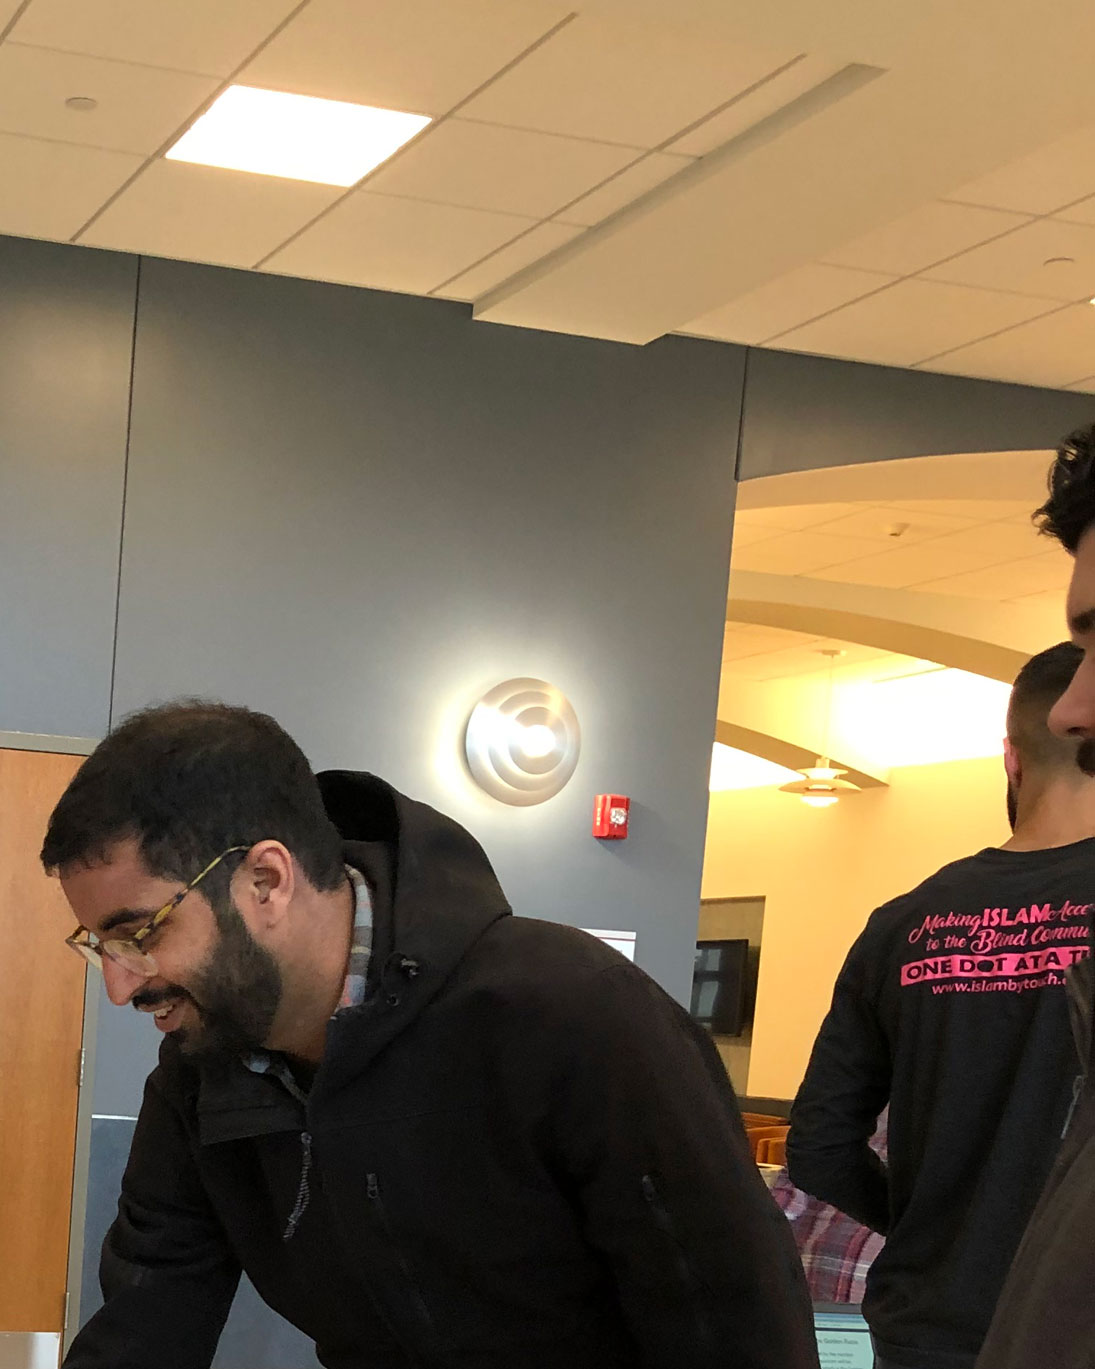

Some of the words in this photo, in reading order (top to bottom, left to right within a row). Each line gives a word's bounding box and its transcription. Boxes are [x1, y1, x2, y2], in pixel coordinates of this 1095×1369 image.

[908, 912, 982, 944] Making
[982, 903, 1051, 927] ISLAM
[926, 937, 939, 951] to
[944, 935, 967, 948] the
[970, 928, 1028, 954] Blind
[906, 959, 952, 980] ONE
[959, 958, 1007, 973] DOT
[1014, 955, 1042, 972] AT
[1044, 951, 1062, 966] A
